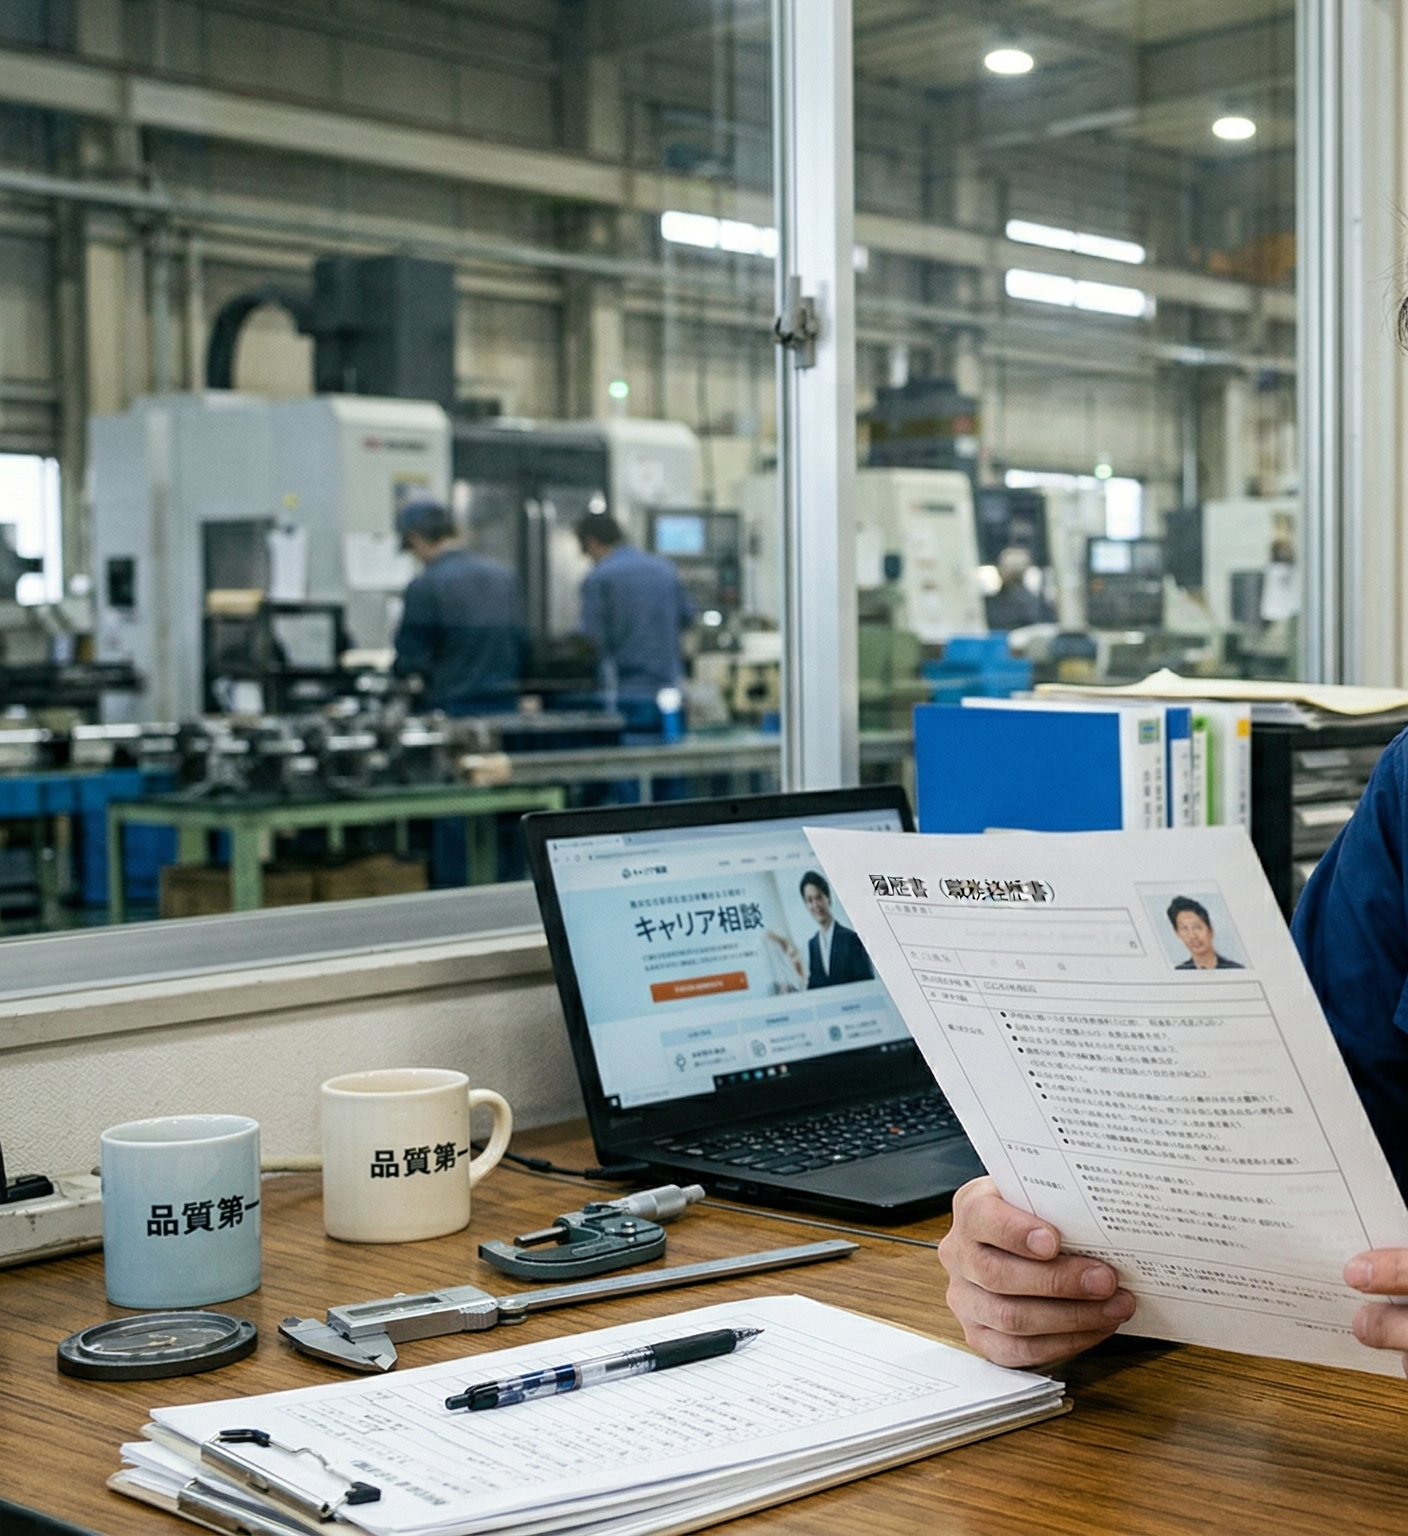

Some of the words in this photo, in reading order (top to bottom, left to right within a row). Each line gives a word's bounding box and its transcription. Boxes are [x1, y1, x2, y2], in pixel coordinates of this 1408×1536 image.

[635, 902, 764, 943] キャリア相談
